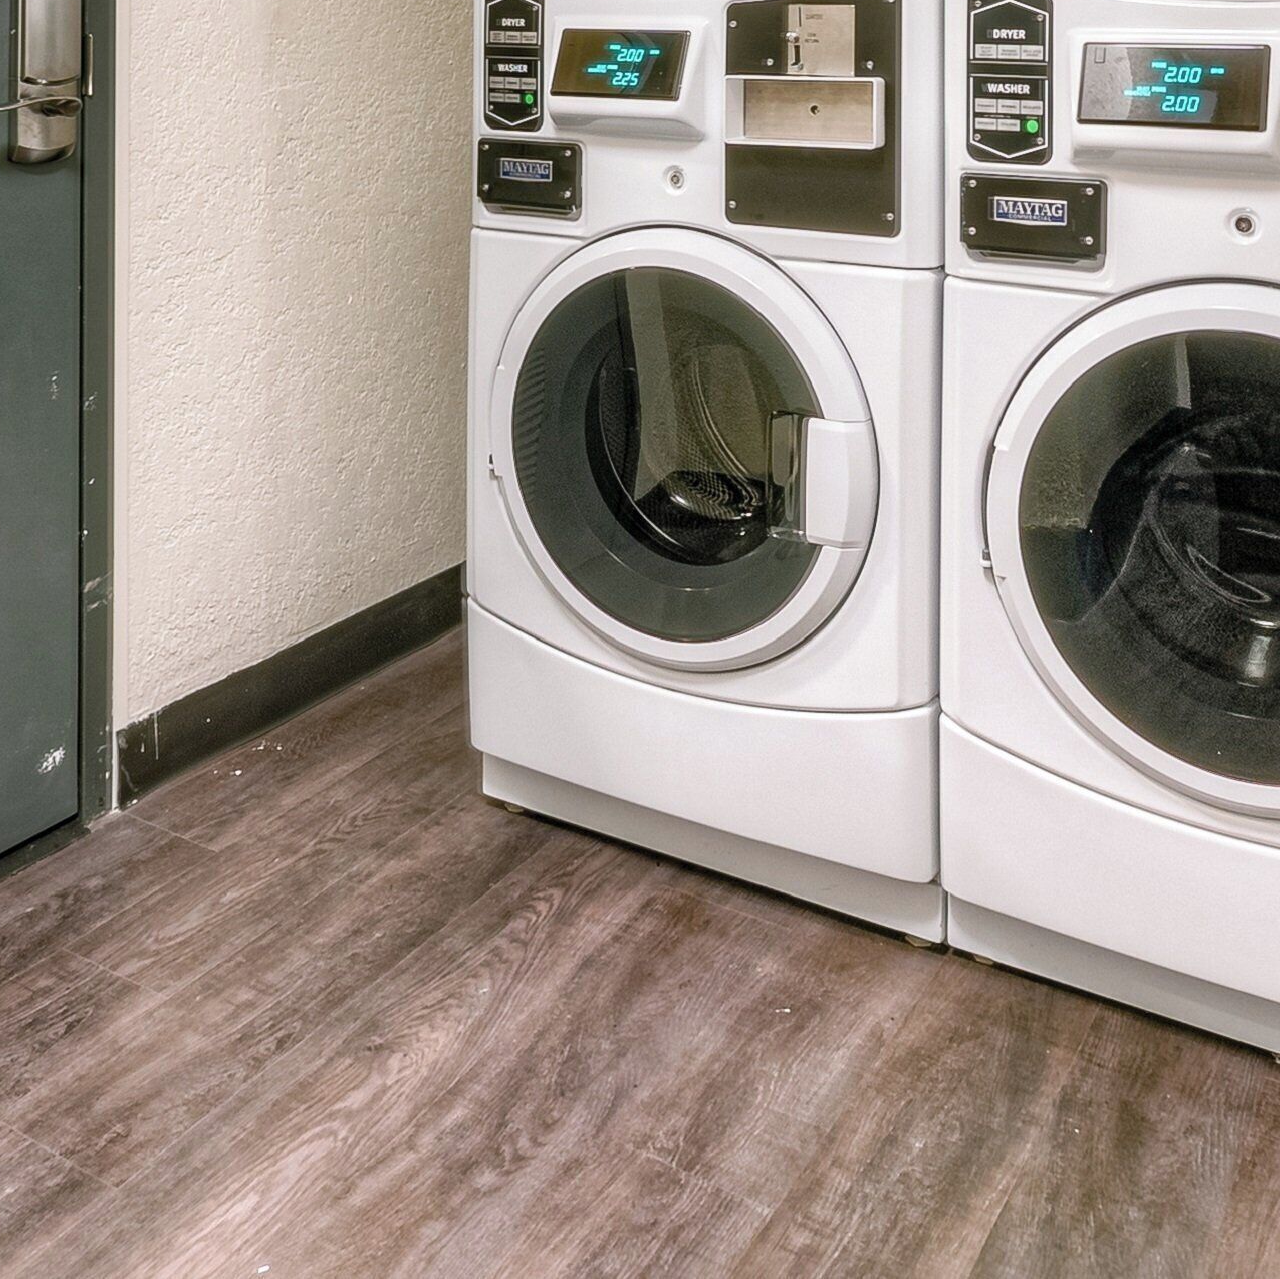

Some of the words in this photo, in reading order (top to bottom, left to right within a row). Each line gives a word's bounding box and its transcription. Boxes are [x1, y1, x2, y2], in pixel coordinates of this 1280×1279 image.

[501, 18, 526, 27] DRYER
[992, 28, 1026, 40] DRYER
[616, 48, 645, 62] 2.00
[497, 63, 529, 73] WASHER
[1164, 66, 1202, 84] 2.00
[611, 71, 640, 86] 2.25
[987, 82, 1031, 95] WASHER
[1161, 95, 1200, 113] 2.00
[503, 161, 549, 175] MAYTAG
[997, 200, 1064, 217] MAYTAG
